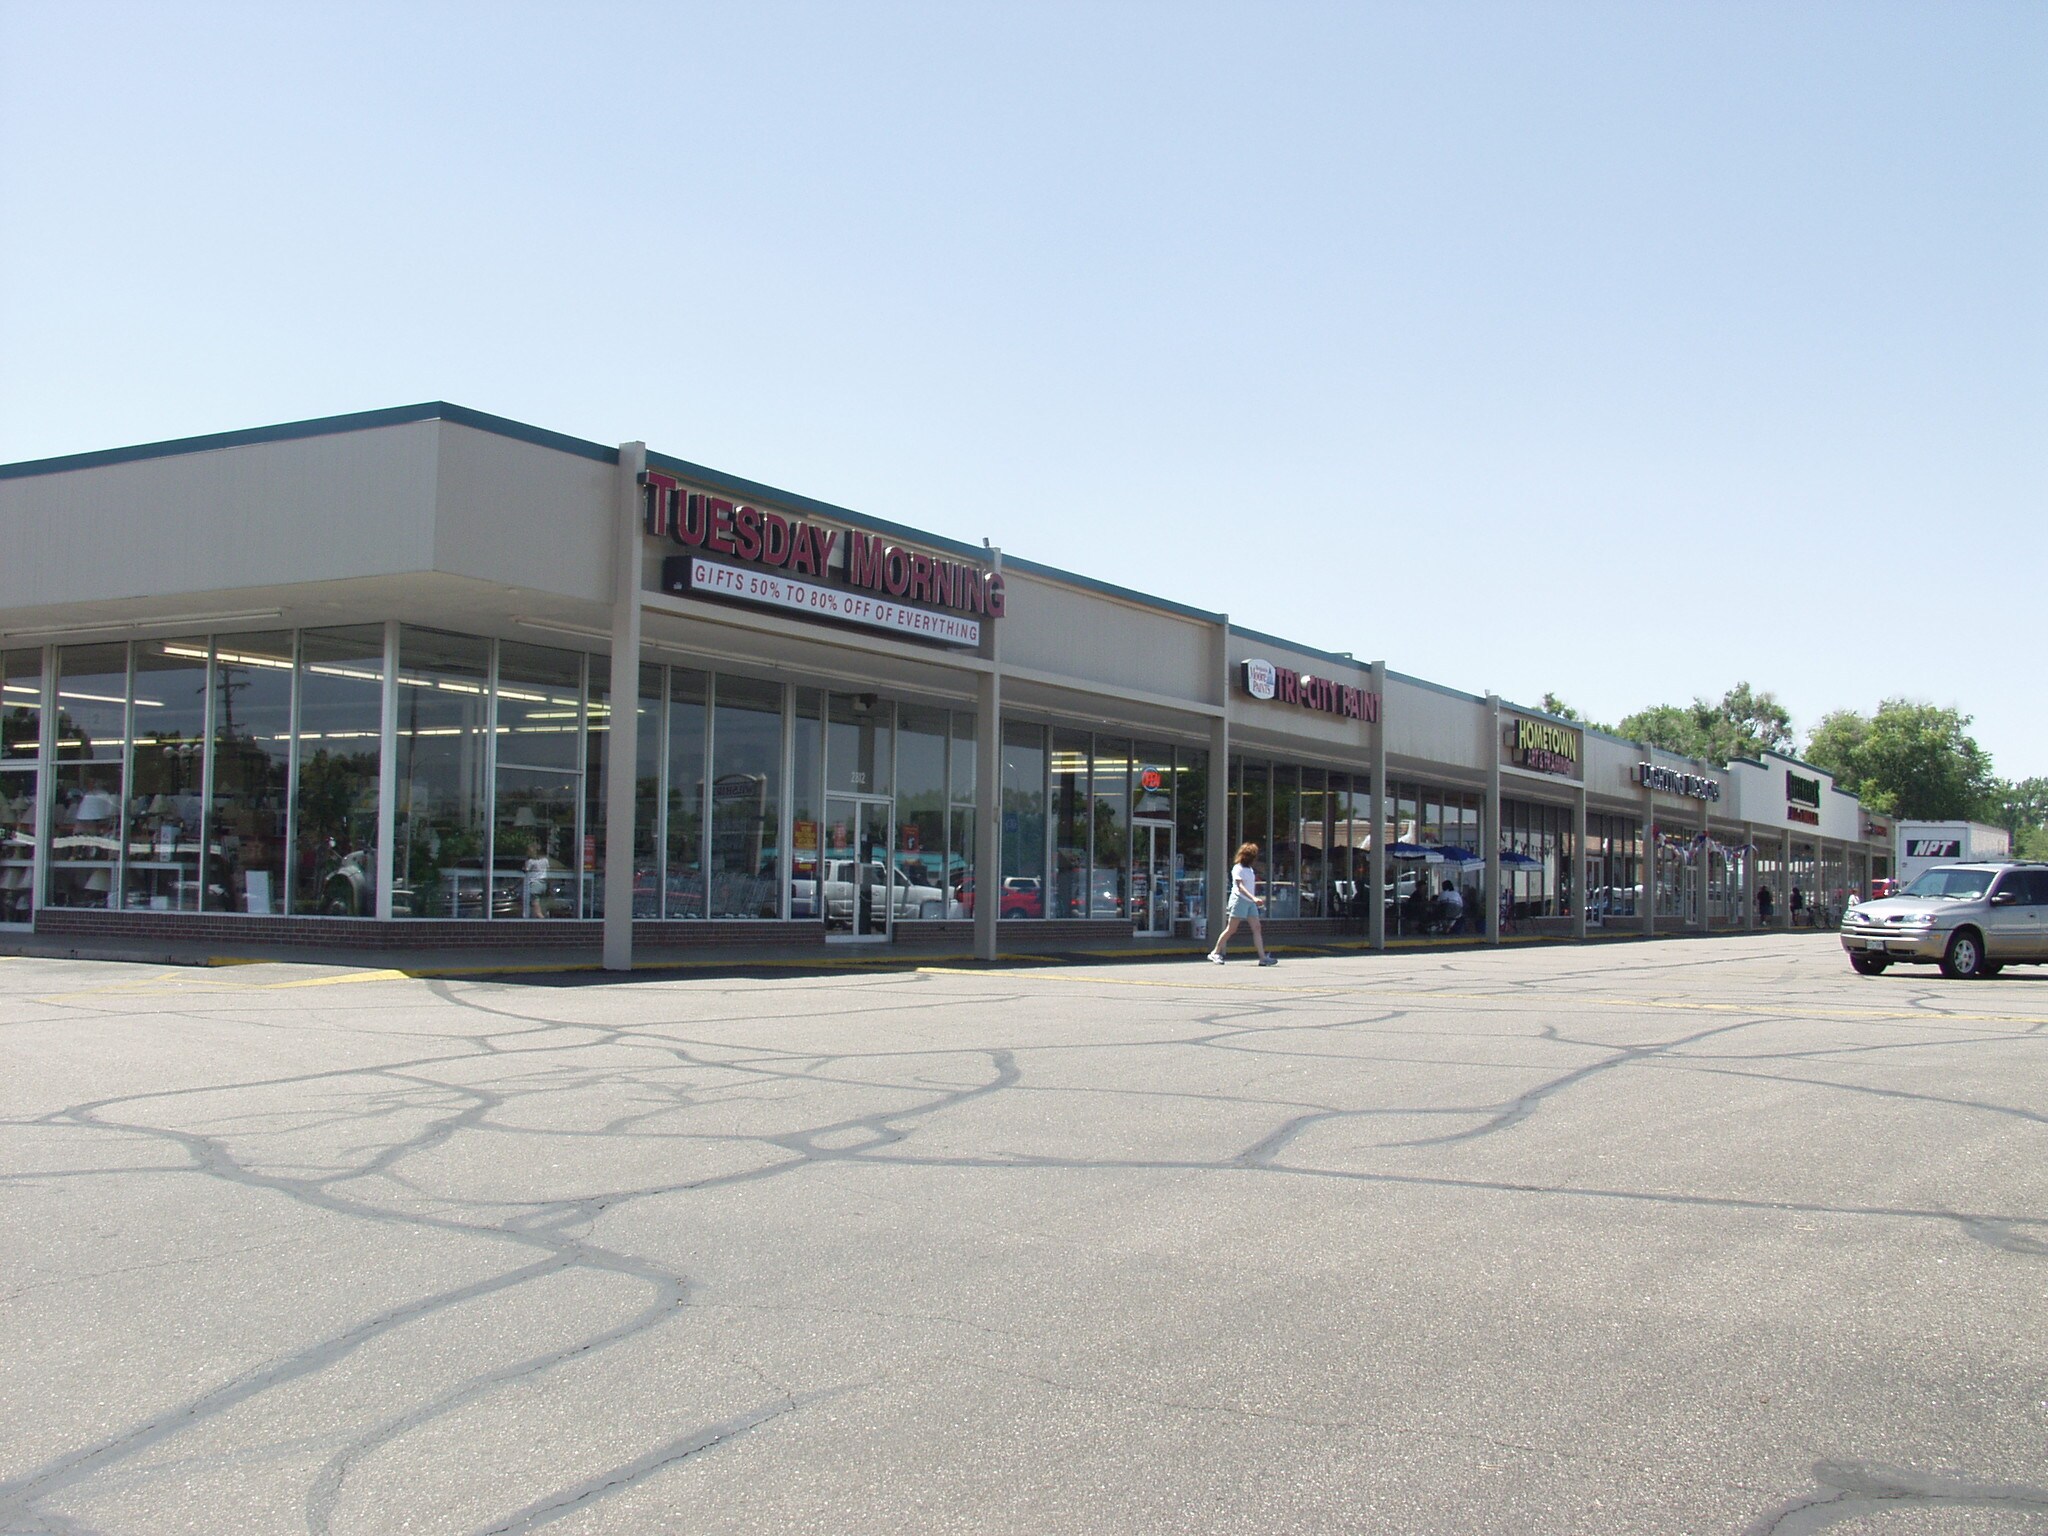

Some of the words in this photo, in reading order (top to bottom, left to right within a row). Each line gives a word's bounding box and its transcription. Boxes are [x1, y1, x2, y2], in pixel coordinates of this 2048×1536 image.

[646, 471, 836, 578] TUESDAY
[850, 528, 1006, 619] MORNING
[695, 565, 744, 591] GIFTS
[750, 578, 780, 599] 50%
[787, 585, 805, 603] TO
[810, 591, 838, 611] 80%
[844, 598, 871, 617] OFF
[876, 605, 893, 622] OF
[898, 610, 978, 641] EVERYTHING
[1275, 667, 1340, 713] TRI-CITY
[1342, 685, 1382, 723] PAINT
[1518, 719, 1577, 762] HOMETOWN
[1142, 771, 1161, 787] OPEN
[1639, 762, 1684, 795] LIGHTING
[1912, 840, 1953, 856] NPT
